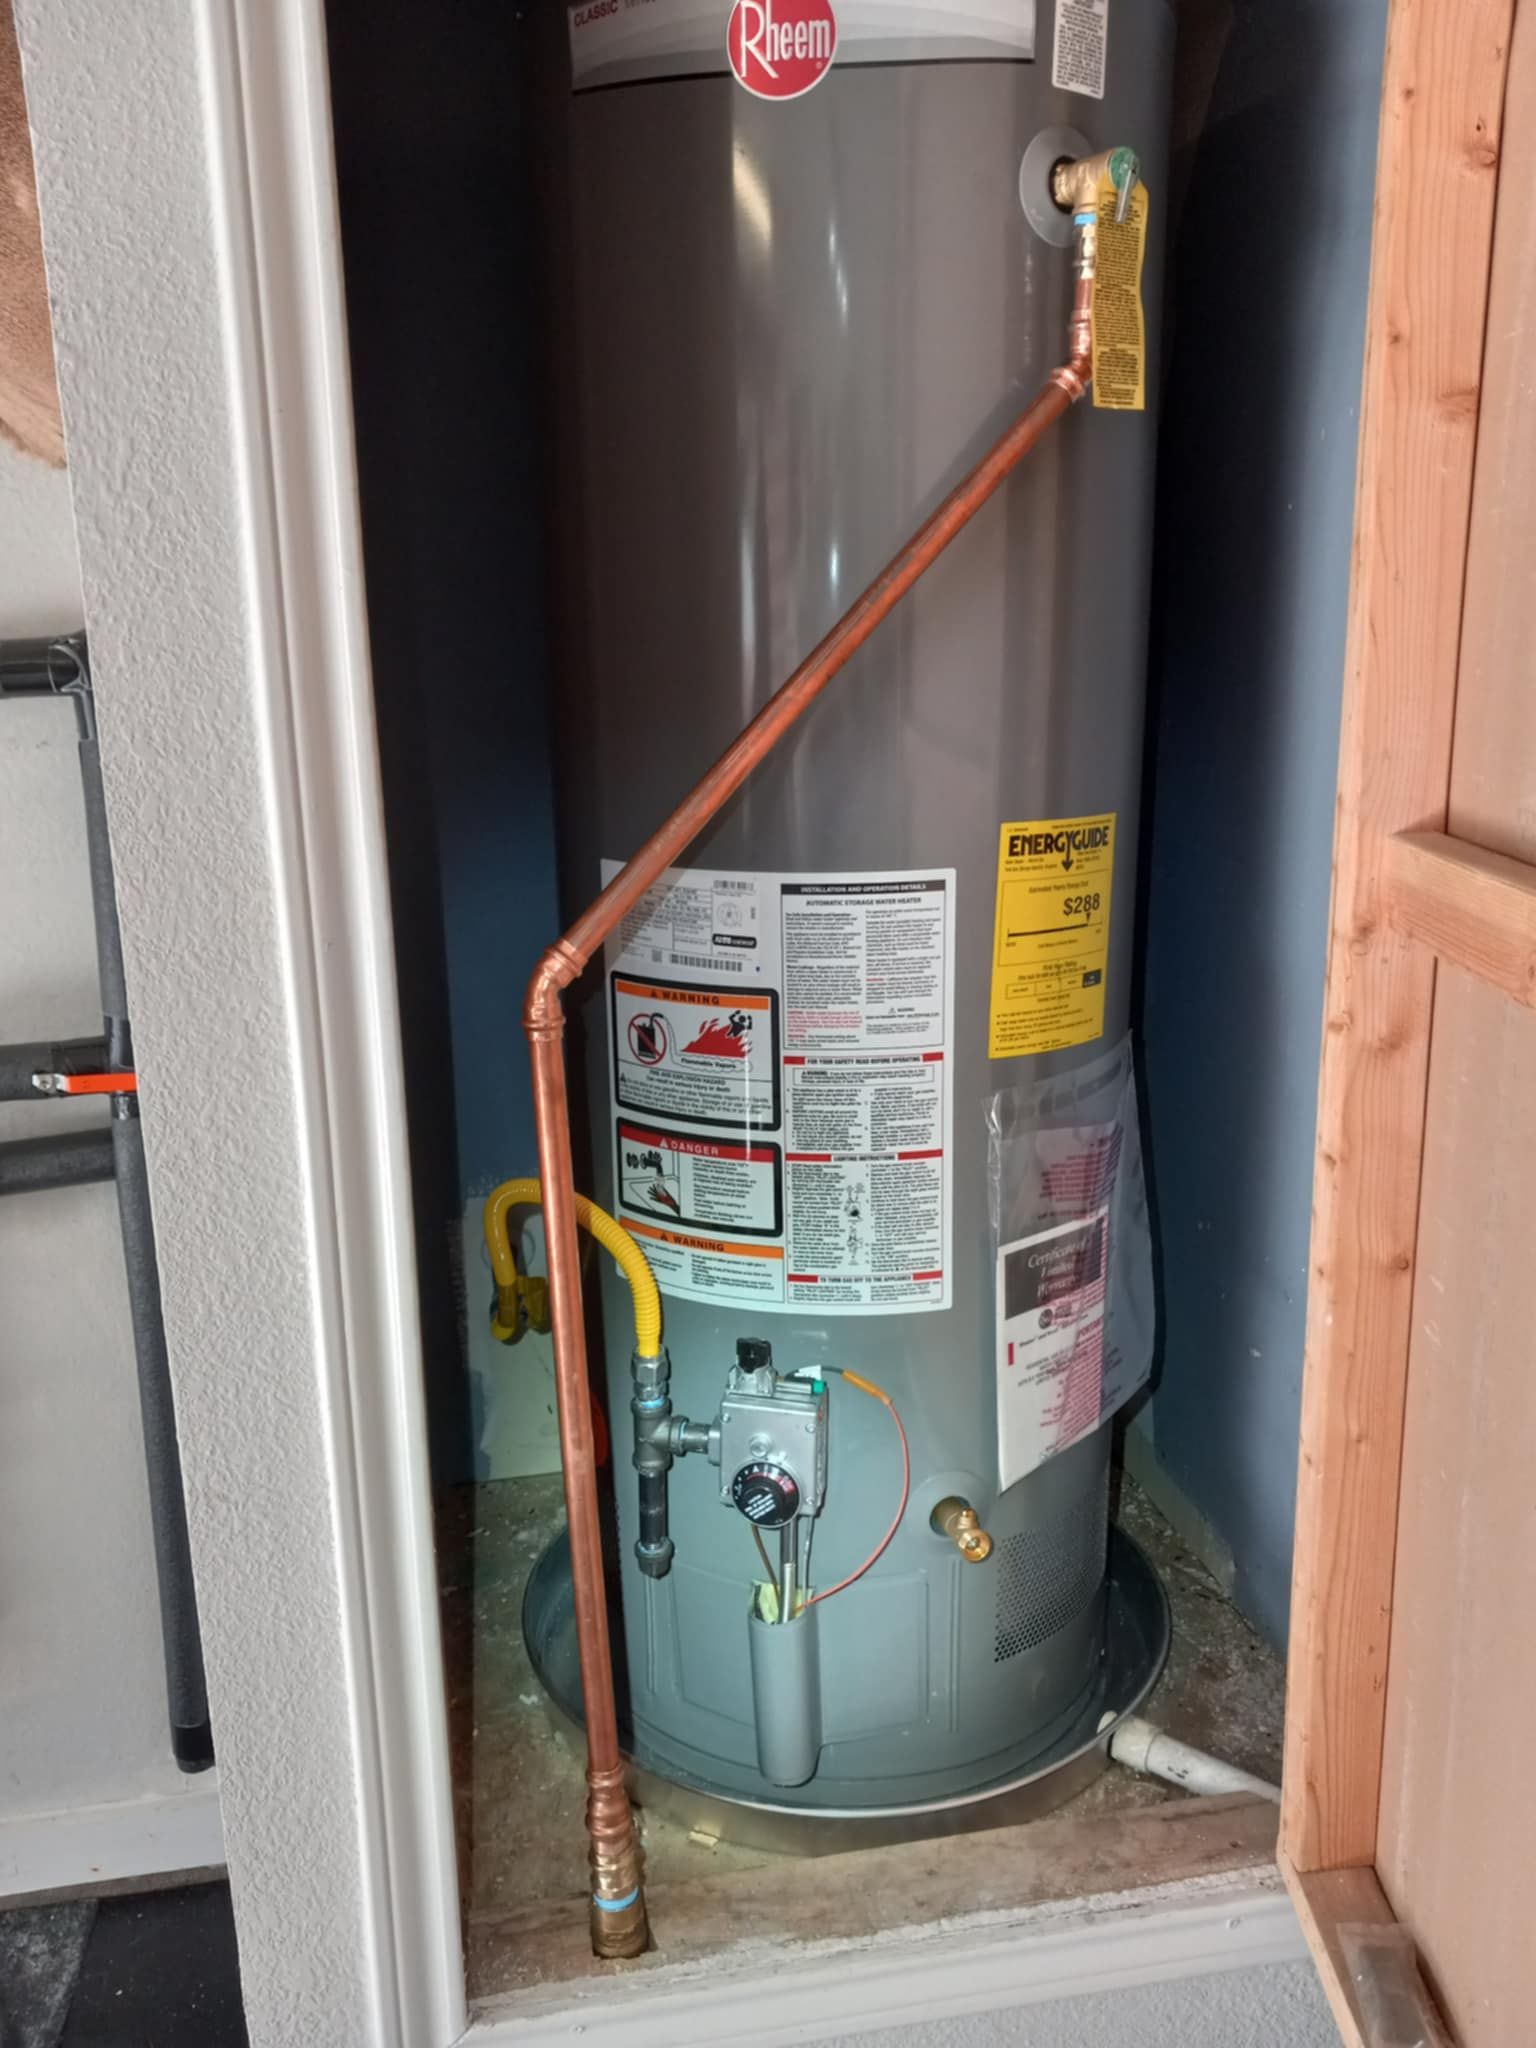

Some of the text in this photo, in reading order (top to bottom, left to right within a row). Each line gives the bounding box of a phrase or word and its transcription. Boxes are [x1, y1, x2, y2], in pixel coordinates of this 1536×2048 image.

[574, 0, 618, 26] CLASSIC
[739, 0, 831, 79] Rheem
[1008, 826, 1110, 858] ENERGYGUIDE
[863, 884, 900, 892] OPERATION
[1063, 893, 1100, 916] $288
[662, 991, 720, 1006] WARNING
[681, 1057, 737, 1070] Flammable Vapors
[671, 1141, 719, 1156] DANGER
[673, 1234, 724, 1252] WARNING
